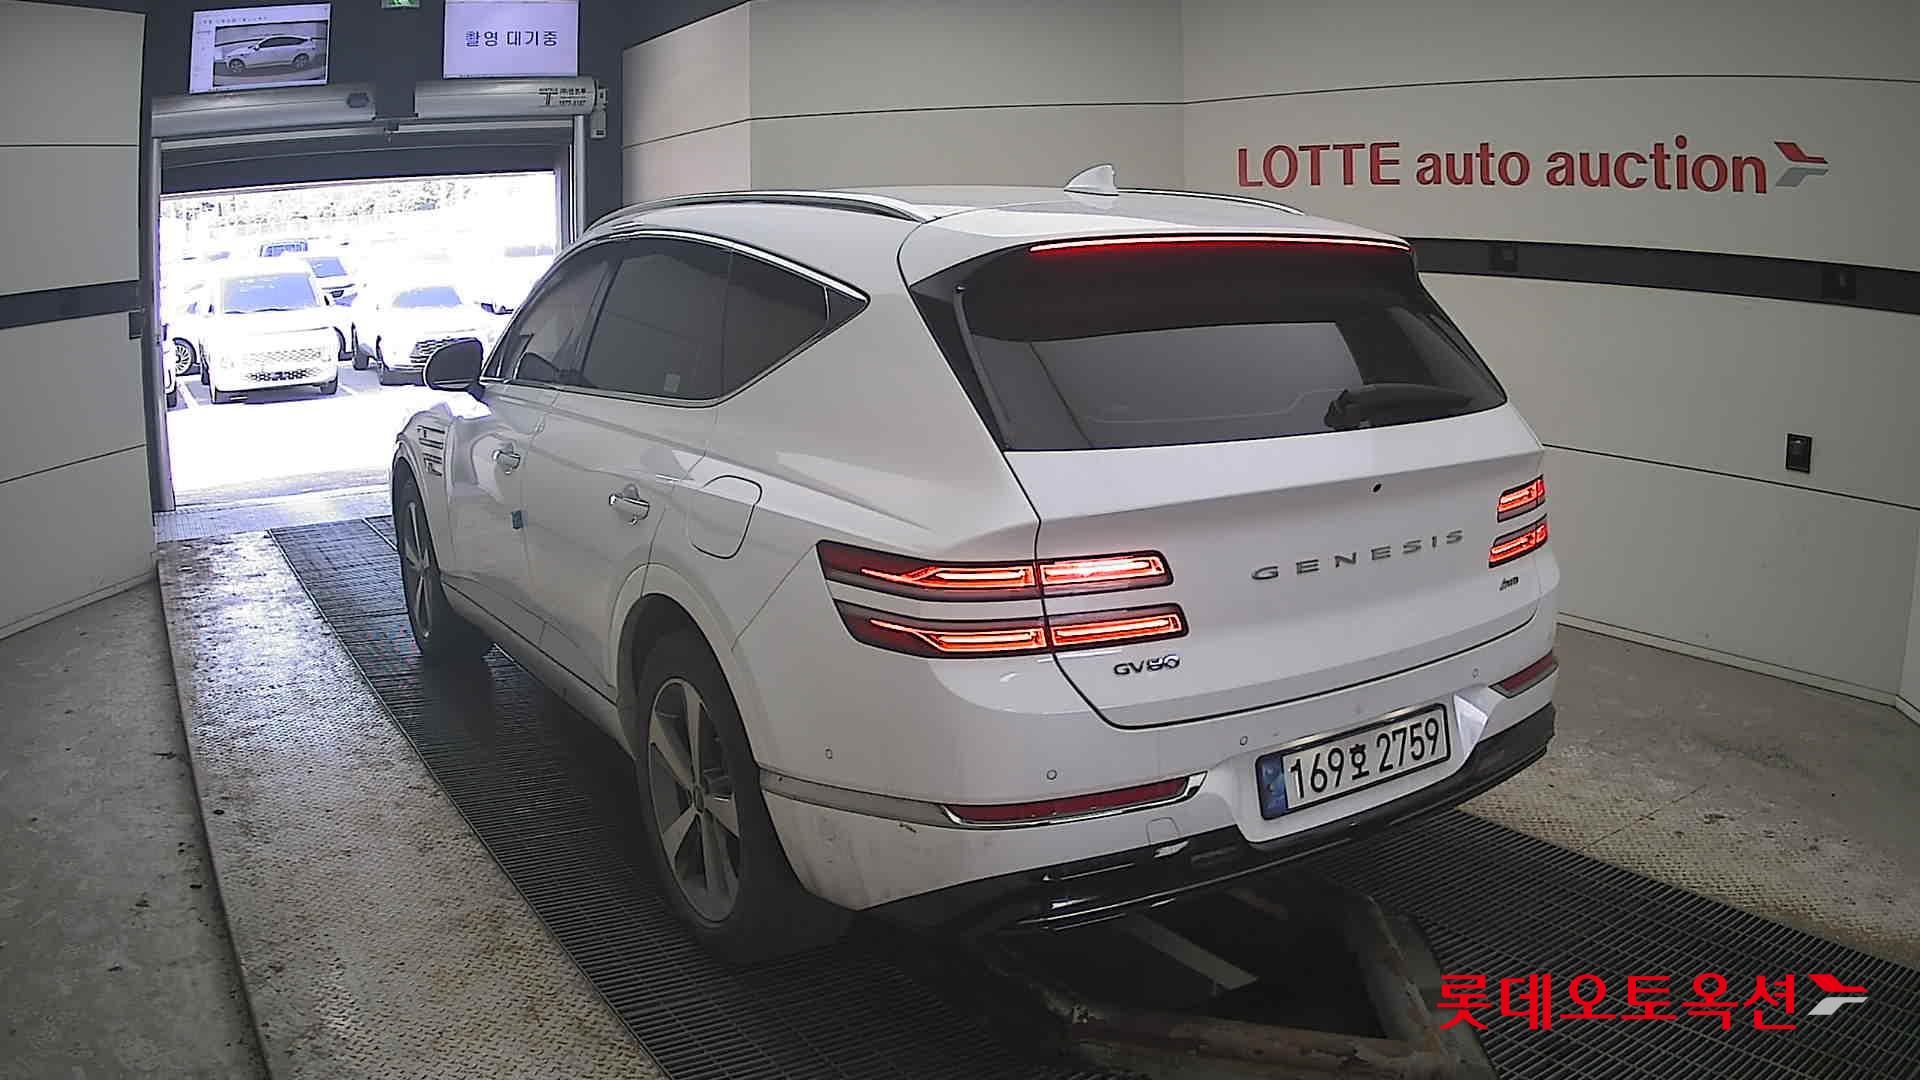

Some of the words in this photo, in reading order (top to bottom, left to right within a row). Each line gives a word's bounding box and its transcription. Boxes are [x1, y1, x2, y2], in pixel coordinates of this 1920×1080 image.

[1237, 142, 1401, 188] LOTTE
[1416, 142, 1531, 186] auto
[1546, 135, 1767, 194] auction
[1251, 529, 1463, 581] GENESIS
[1376, 717, 1439, 773] 2759
